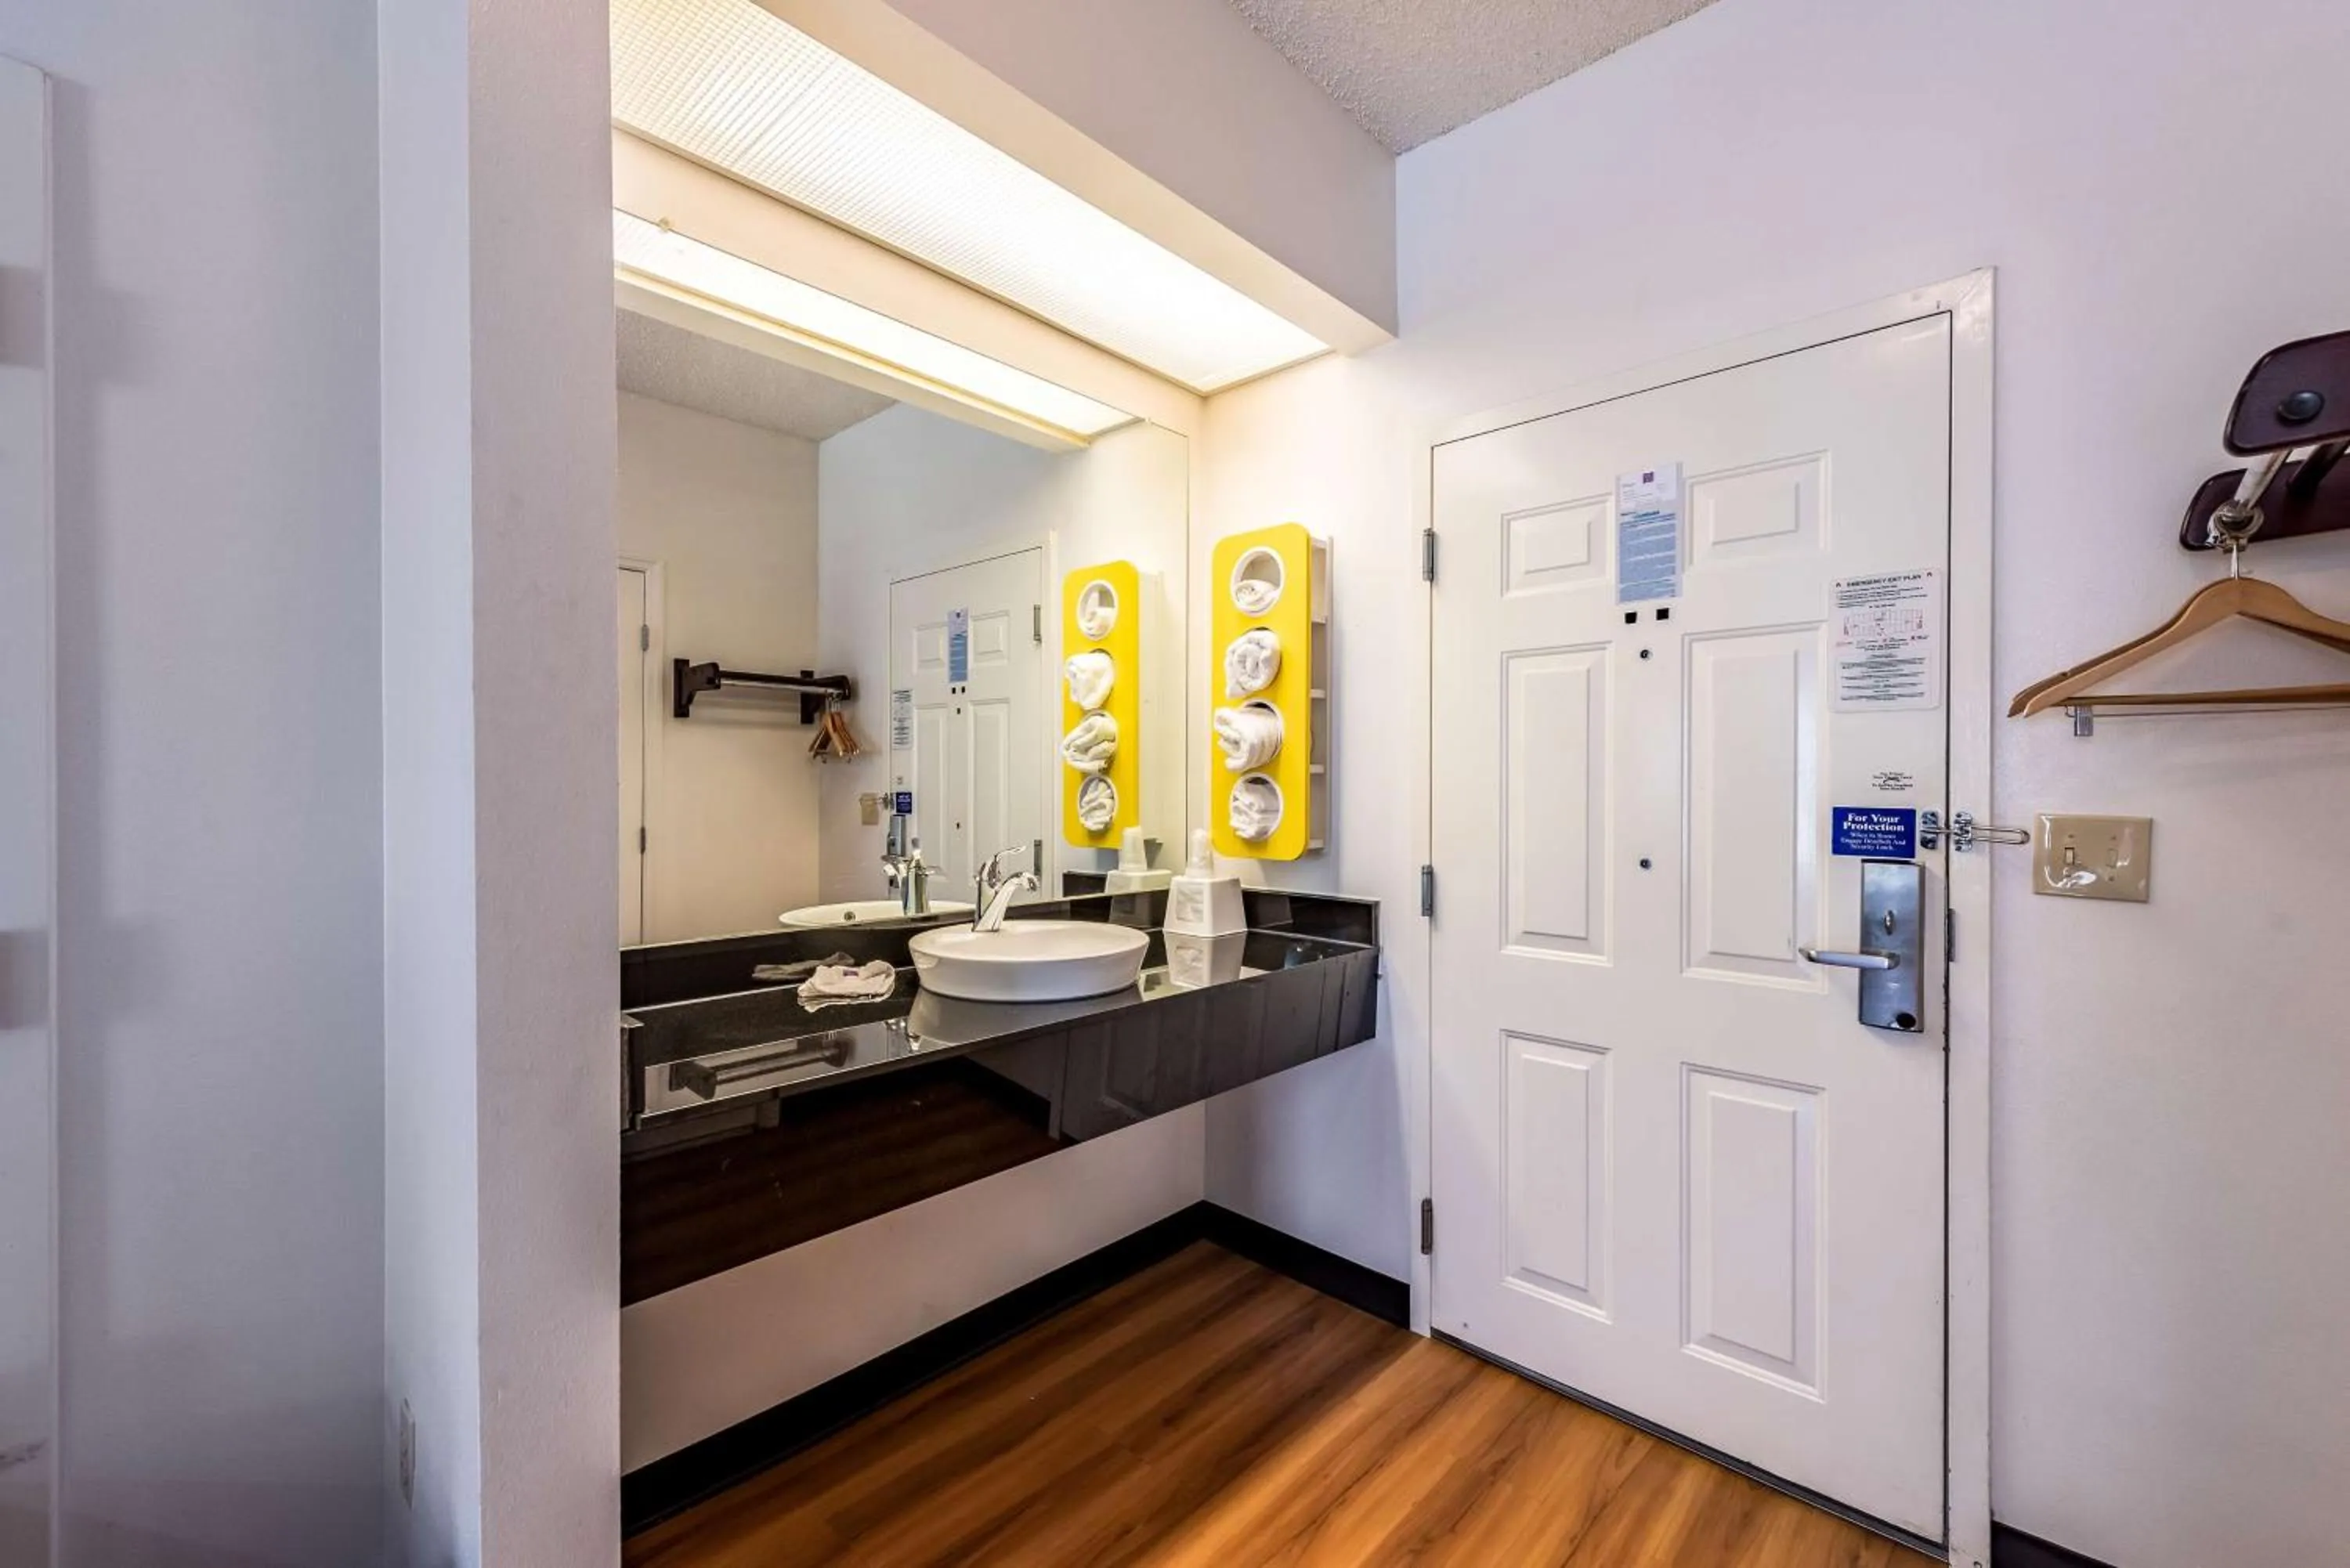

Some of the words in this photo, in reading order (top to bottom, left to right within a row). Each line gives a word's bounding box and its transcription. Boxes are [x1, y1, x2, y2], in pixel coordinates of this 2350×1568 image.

[1848, 813, 1867, 822] For
[1871, 814, 1900, 822] Your
[1843, 822, 1904, 831] Protection
